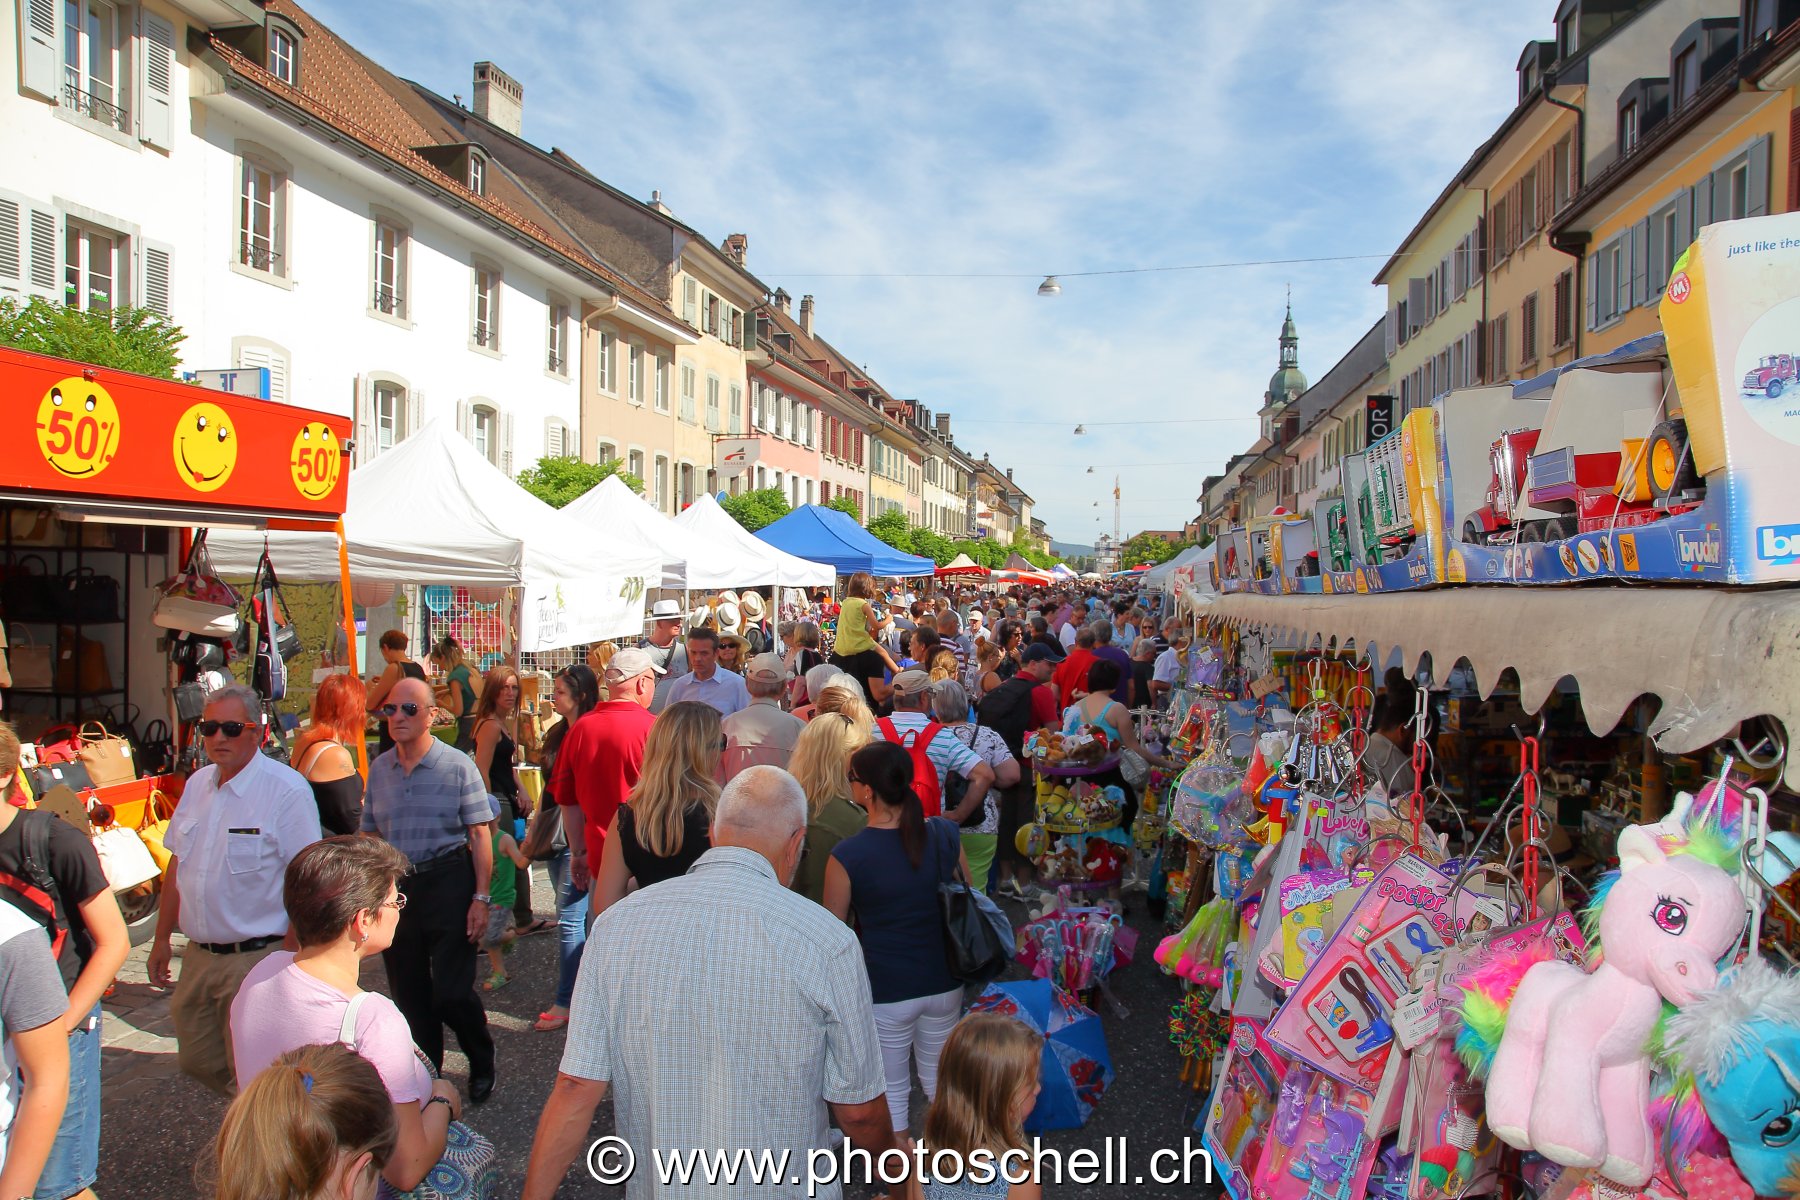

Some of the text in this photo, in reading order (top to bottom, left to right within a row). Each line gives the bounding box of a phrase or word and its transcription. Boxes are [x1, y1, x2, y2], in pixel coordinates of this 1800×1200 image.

[1727, 237, 1800, 258] just like the
[1679, 533, 1720, 564] bruder
